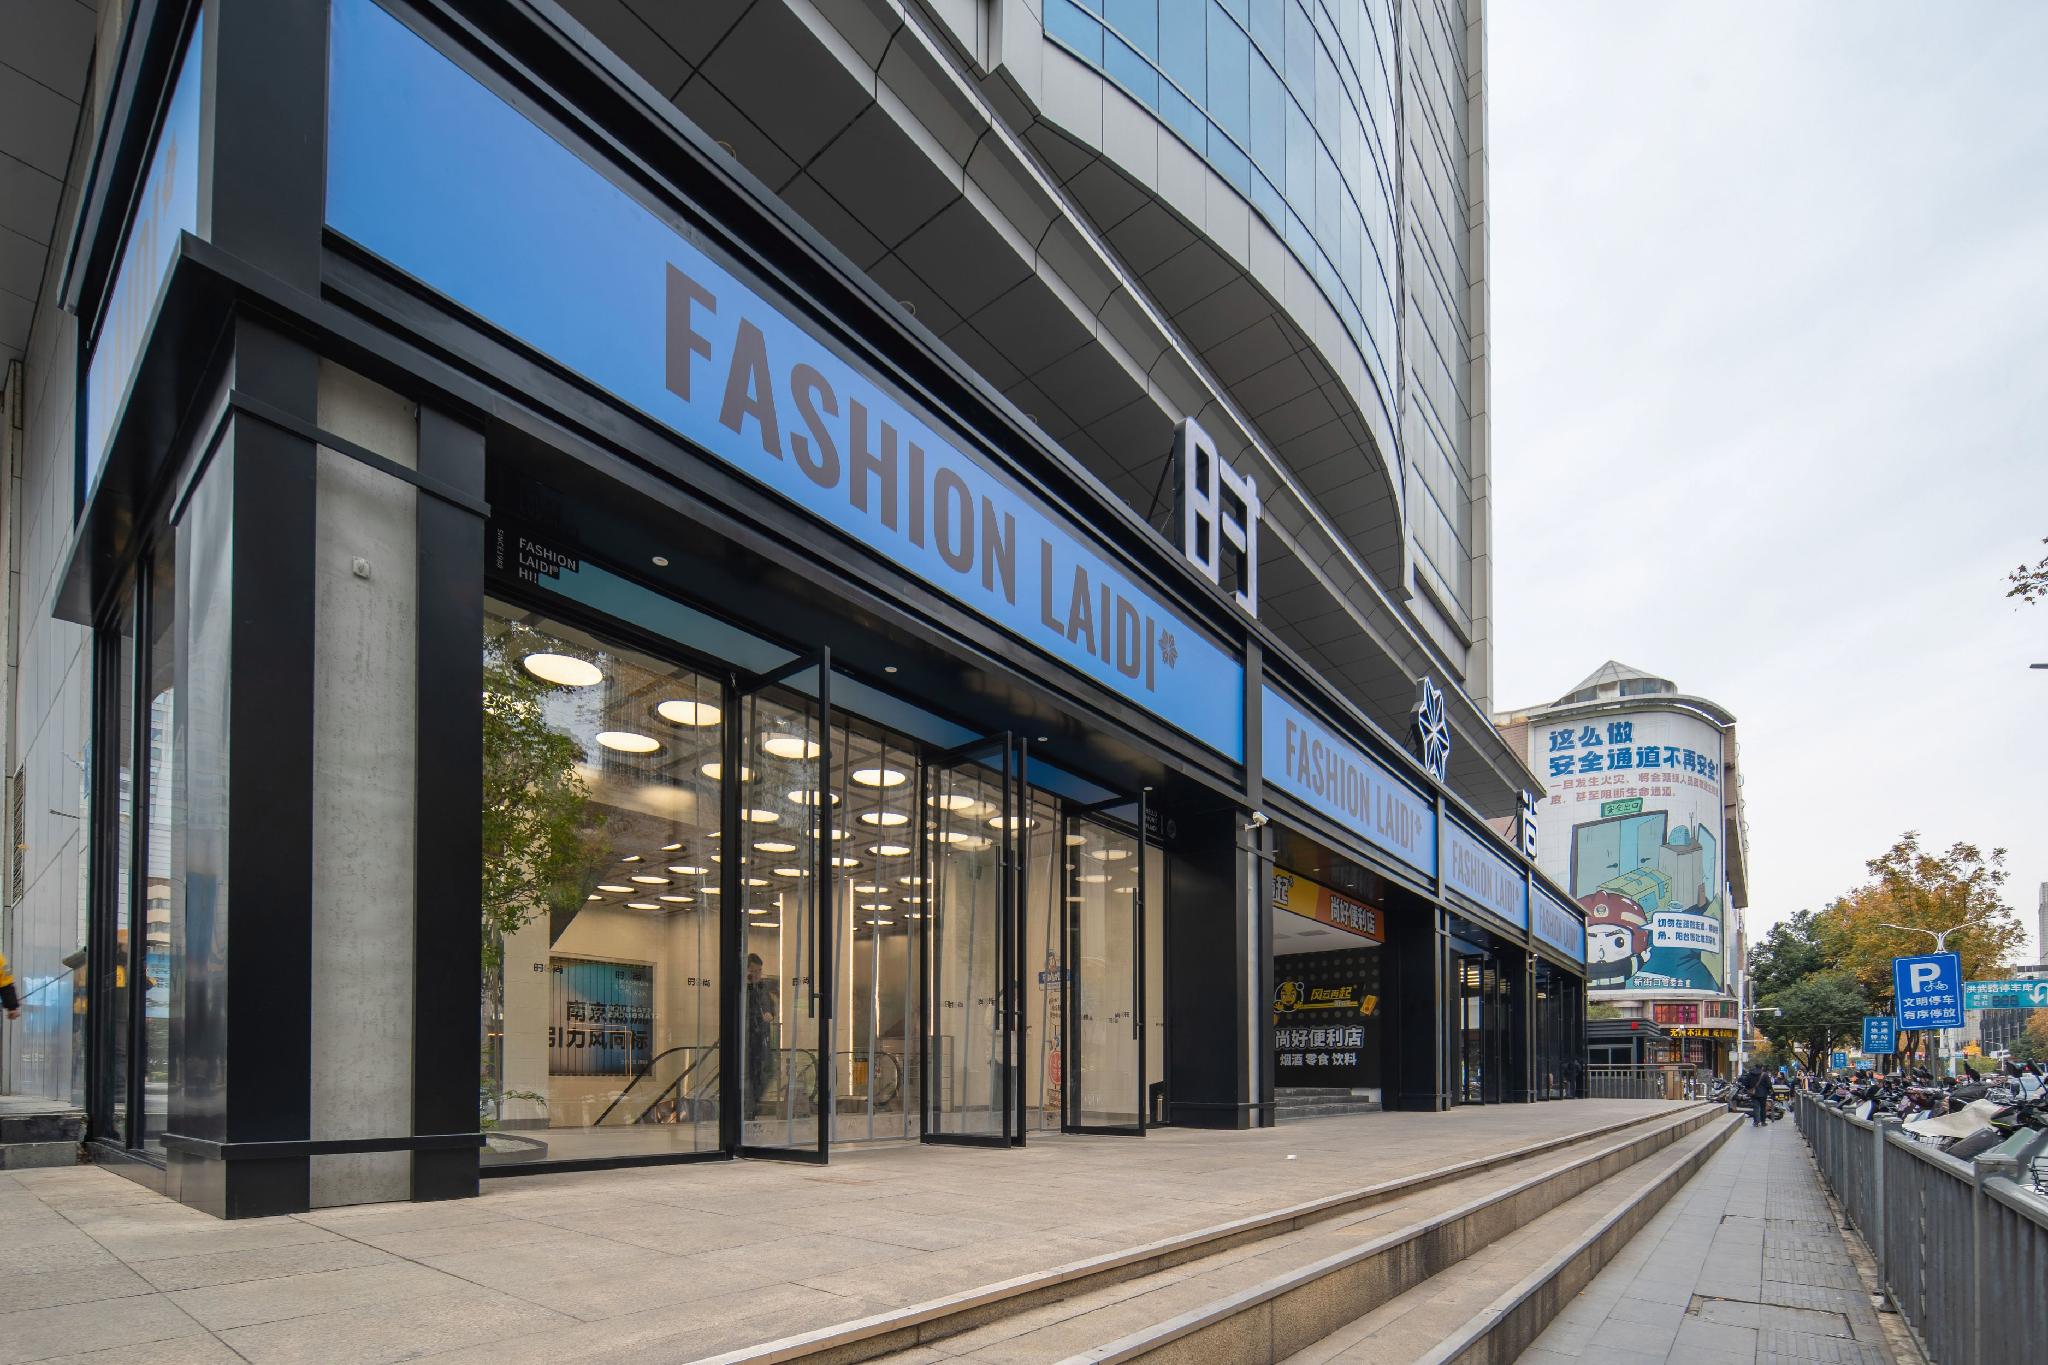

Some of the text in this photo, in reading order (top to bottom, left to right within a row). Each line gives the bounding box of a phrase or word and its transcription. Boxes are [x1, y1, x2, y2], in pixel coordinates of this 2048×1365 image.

[666, 261, 1016, 607] FASHION
[1184, 416, 1262, 620] 时
[520, 537, 576, 571] FASHION
[519, 567, 537, 584] HI!
[1549, 721, 1633, 752] 这么做
[1285, 718, 1370, 828] FASHION
[1607, 802, 1639, 815] 安全出口
[1451, 839, 1493, 900] FASHION
[1330, 895, 1375, 935] 尚好便利店
[1910, 962, 1941, 994] P
[1966, 983, 2034, 993] 洪武路停车库
[1903, 995, 1956, 1008] 文明停车
[1903, 1007, 1956, 1020] 有序停放
[1274, 1027, 1363, 1049] 尚好便利店
[1280, 1053, 1357, 1066] 烟酒 零食 饮料
